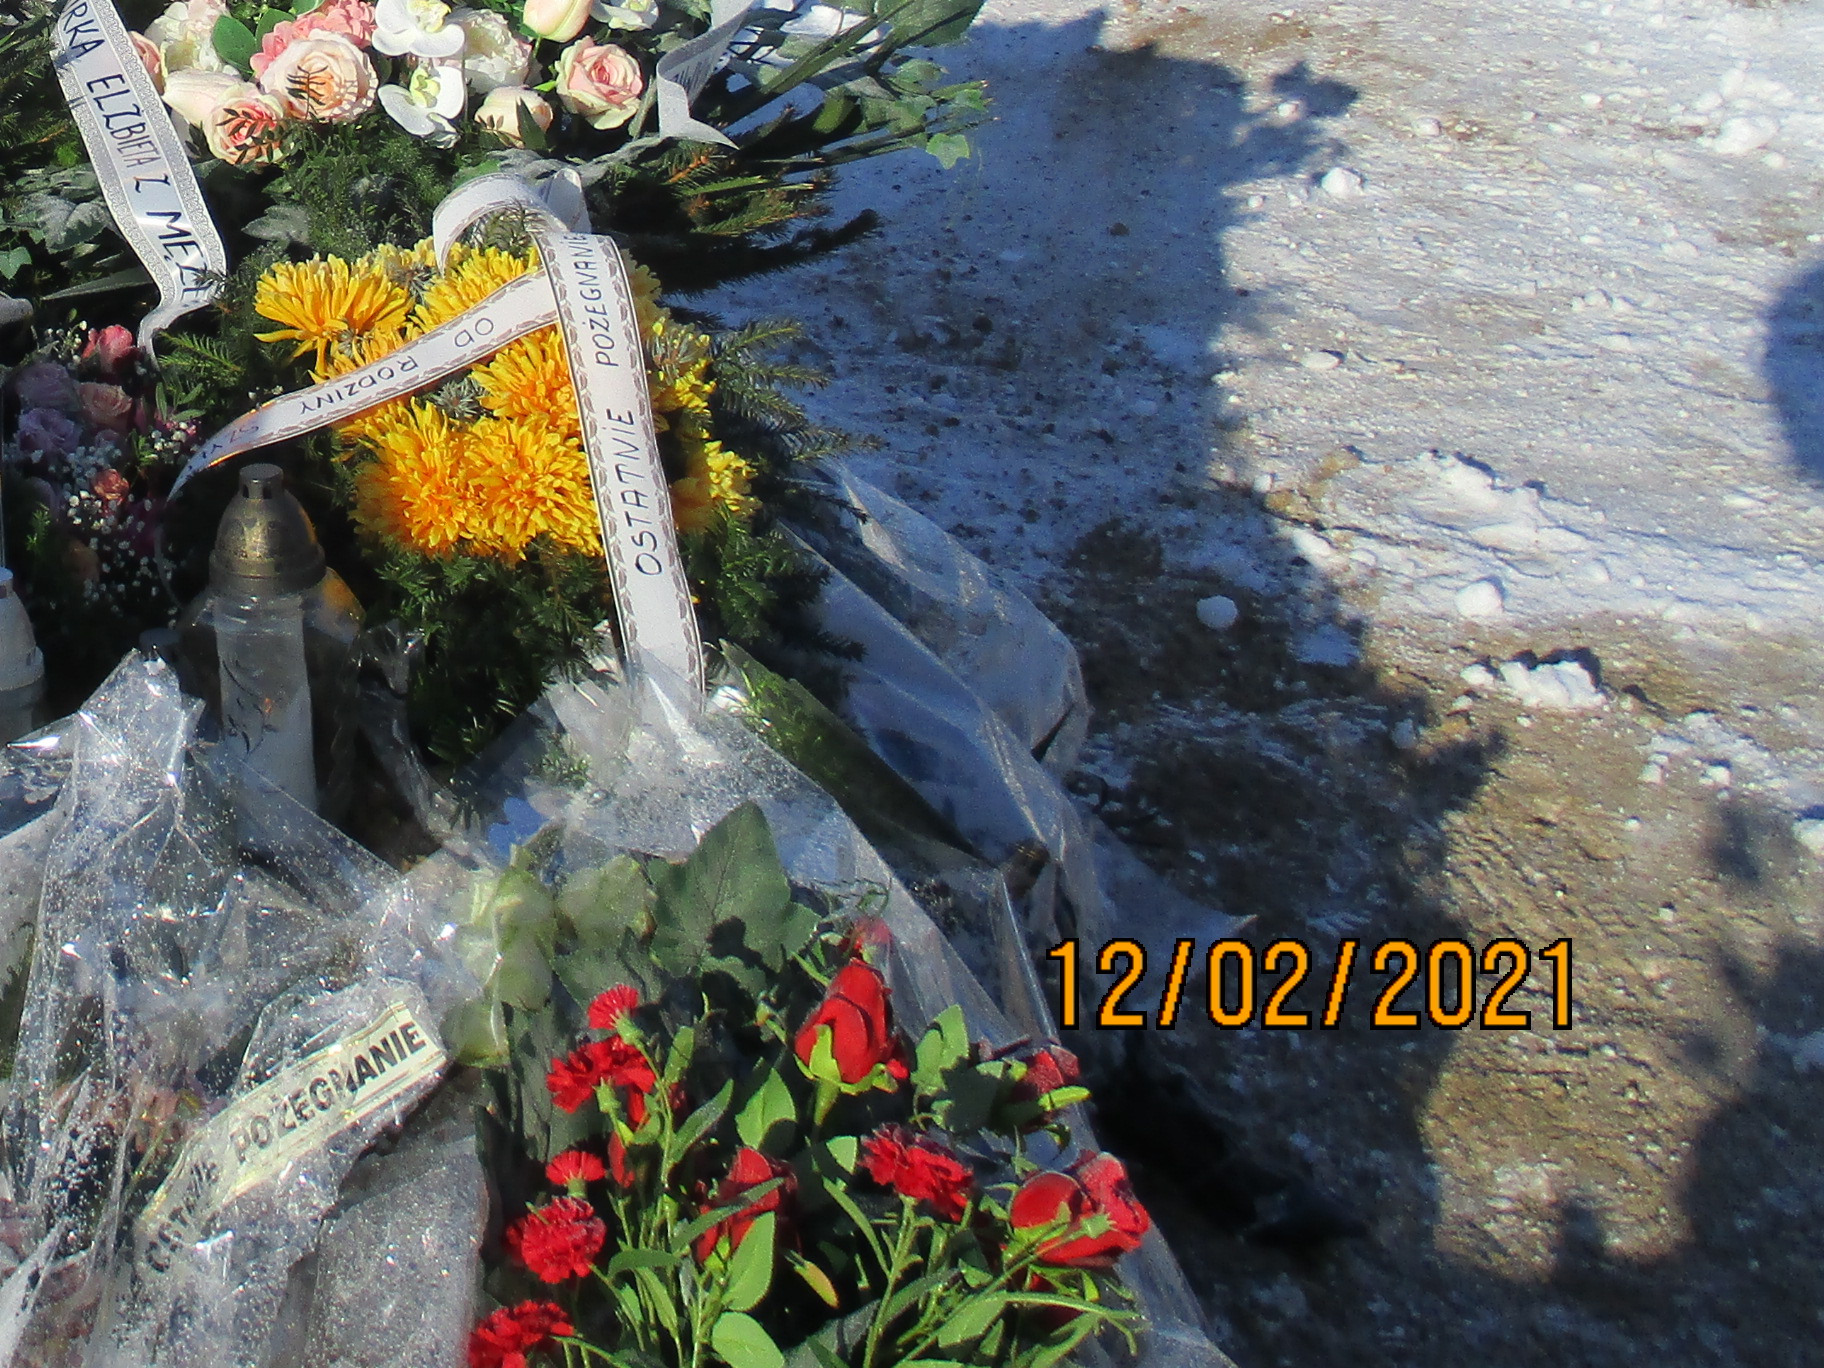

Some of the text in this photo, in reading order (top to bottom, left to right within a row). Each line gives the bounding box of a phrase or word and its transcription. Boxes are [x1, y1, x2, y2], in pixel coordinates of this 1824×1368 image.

[86, 73, 163, 169] ELŻBIETA
[133, 173, 171, 194] Z
[452, 315, 495, 349] OD
[297, 354, 420, 417] RODZINY
[566, 232, 664, 577] OSTATNIE POŻEGNANIE
